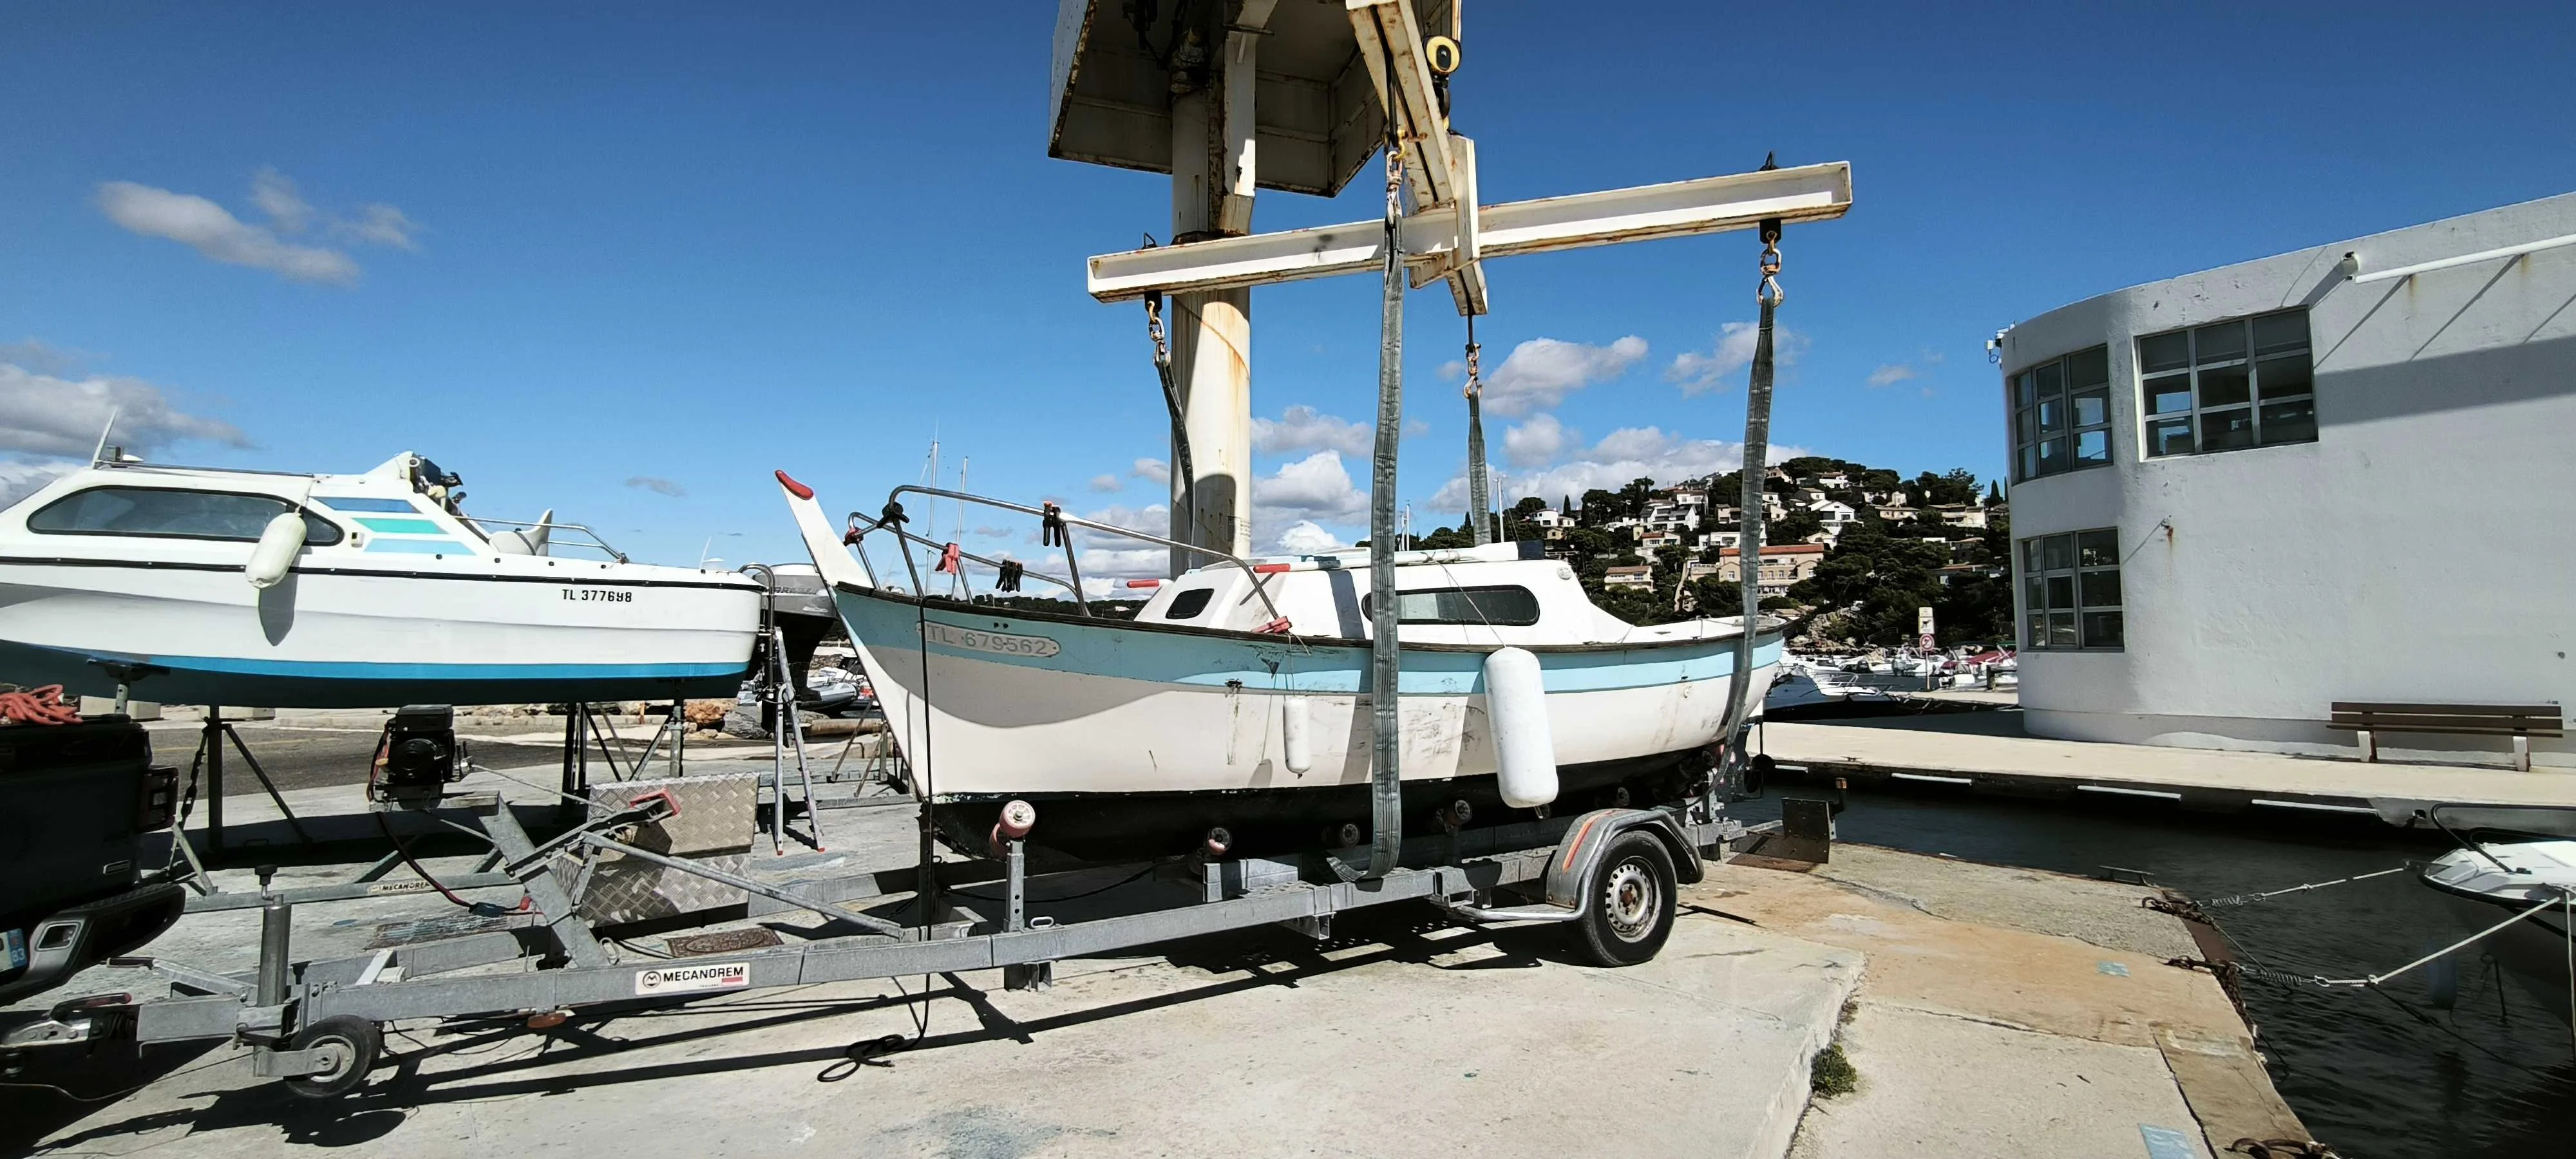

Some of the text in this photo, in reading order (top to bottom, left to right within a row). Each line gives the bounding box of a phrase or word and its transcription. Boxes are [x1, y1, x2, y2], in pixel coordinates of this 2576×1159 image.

[562, 589, 632, 602] TL 377698
[926, 624, 1047, 654] TL 679562
[663, 966, 743, 983] MECANOREM
